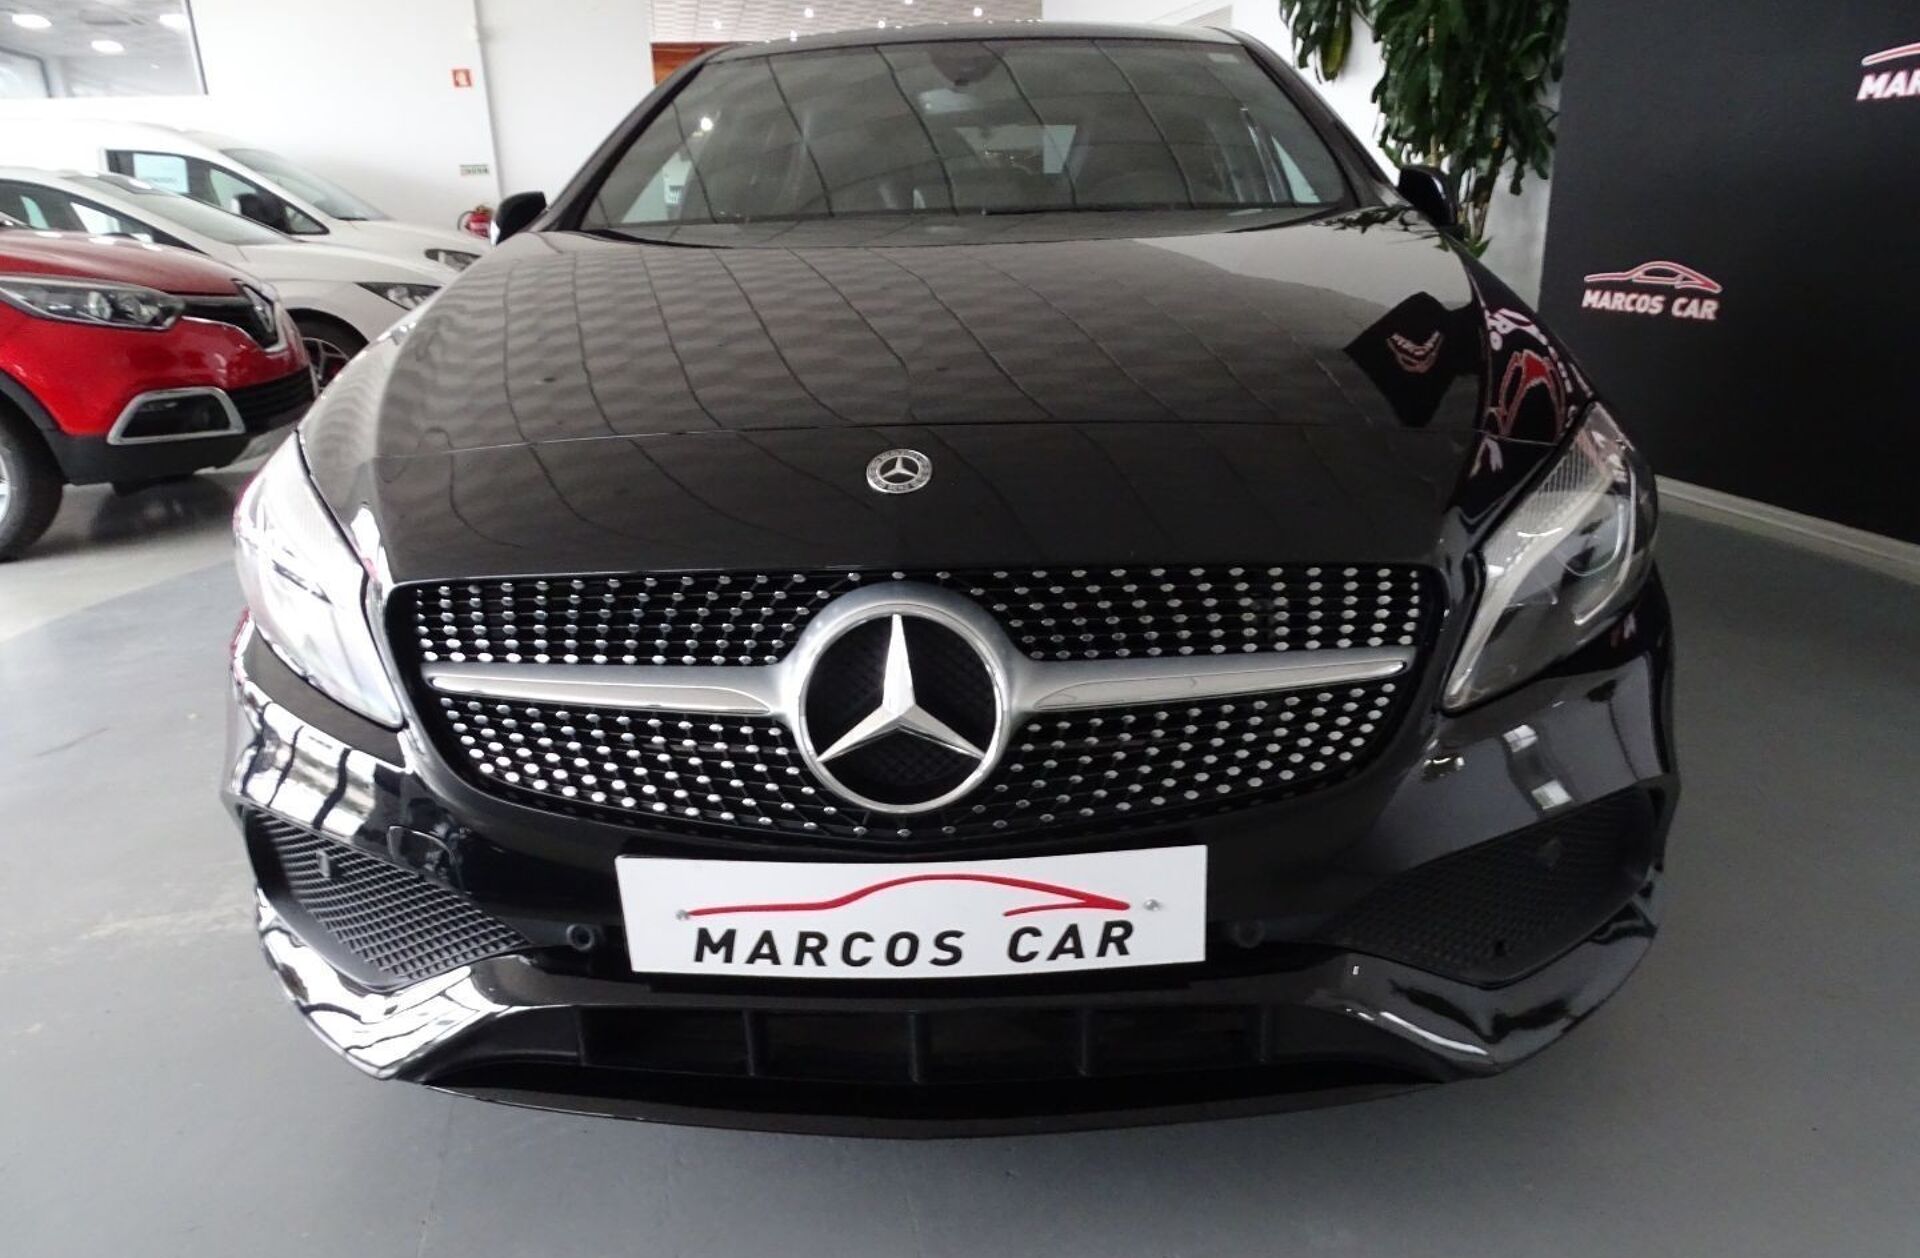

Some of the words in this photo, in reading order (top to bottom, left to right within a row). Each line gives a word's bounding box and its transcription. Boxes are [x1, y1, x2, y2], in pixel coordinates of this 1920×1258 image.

[1581, 289, 1666, 315] MARCOS
[1671, 297, 1719, 320] CAR
[693, 926, 965, 968] MARCOS
[1006, 919, 1136, 964] CAR
